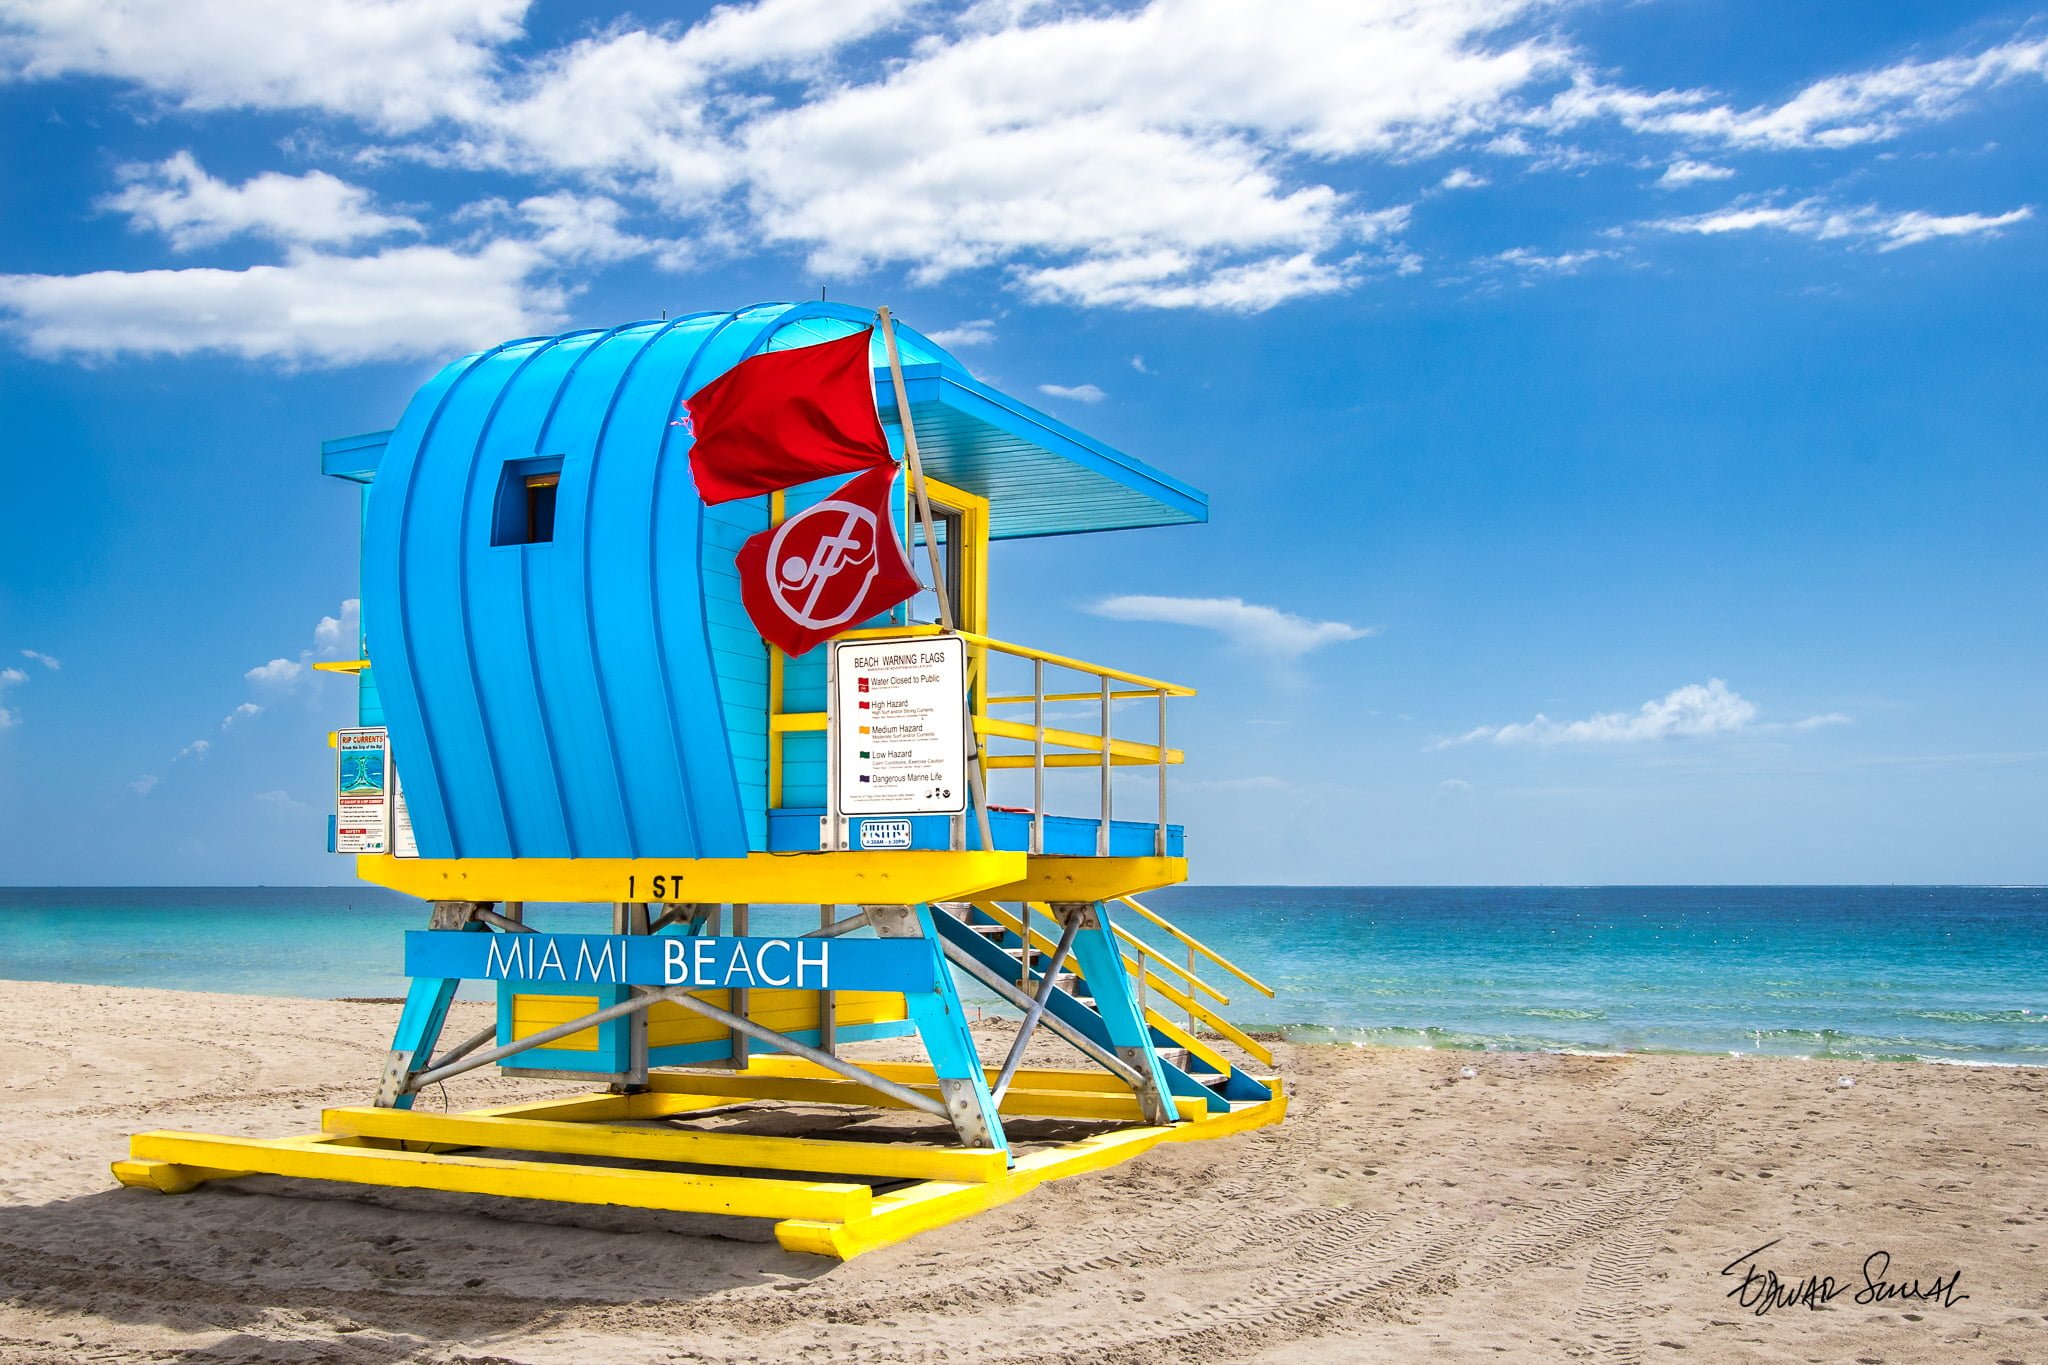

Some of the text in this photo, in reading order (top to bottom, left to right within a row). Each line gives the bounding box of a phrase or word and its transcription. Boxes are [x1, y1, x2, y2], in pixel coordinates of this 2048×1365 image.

[854, 652, 945, 668] BEACH WARNING FLAGS
[871, 677, 889, 686] Water
[890, 676, 911, 685] Closed
[921, 674, 940, 683] Public
[872, 701, 885, 710] High
[900, 724, 923, 732] Hazard
[872, 772, 942, 784] Dangerous Marine Life
[628, 875, 684, 899] 1 ST
[485, 936, 828, 988] MIAMI BEACH
